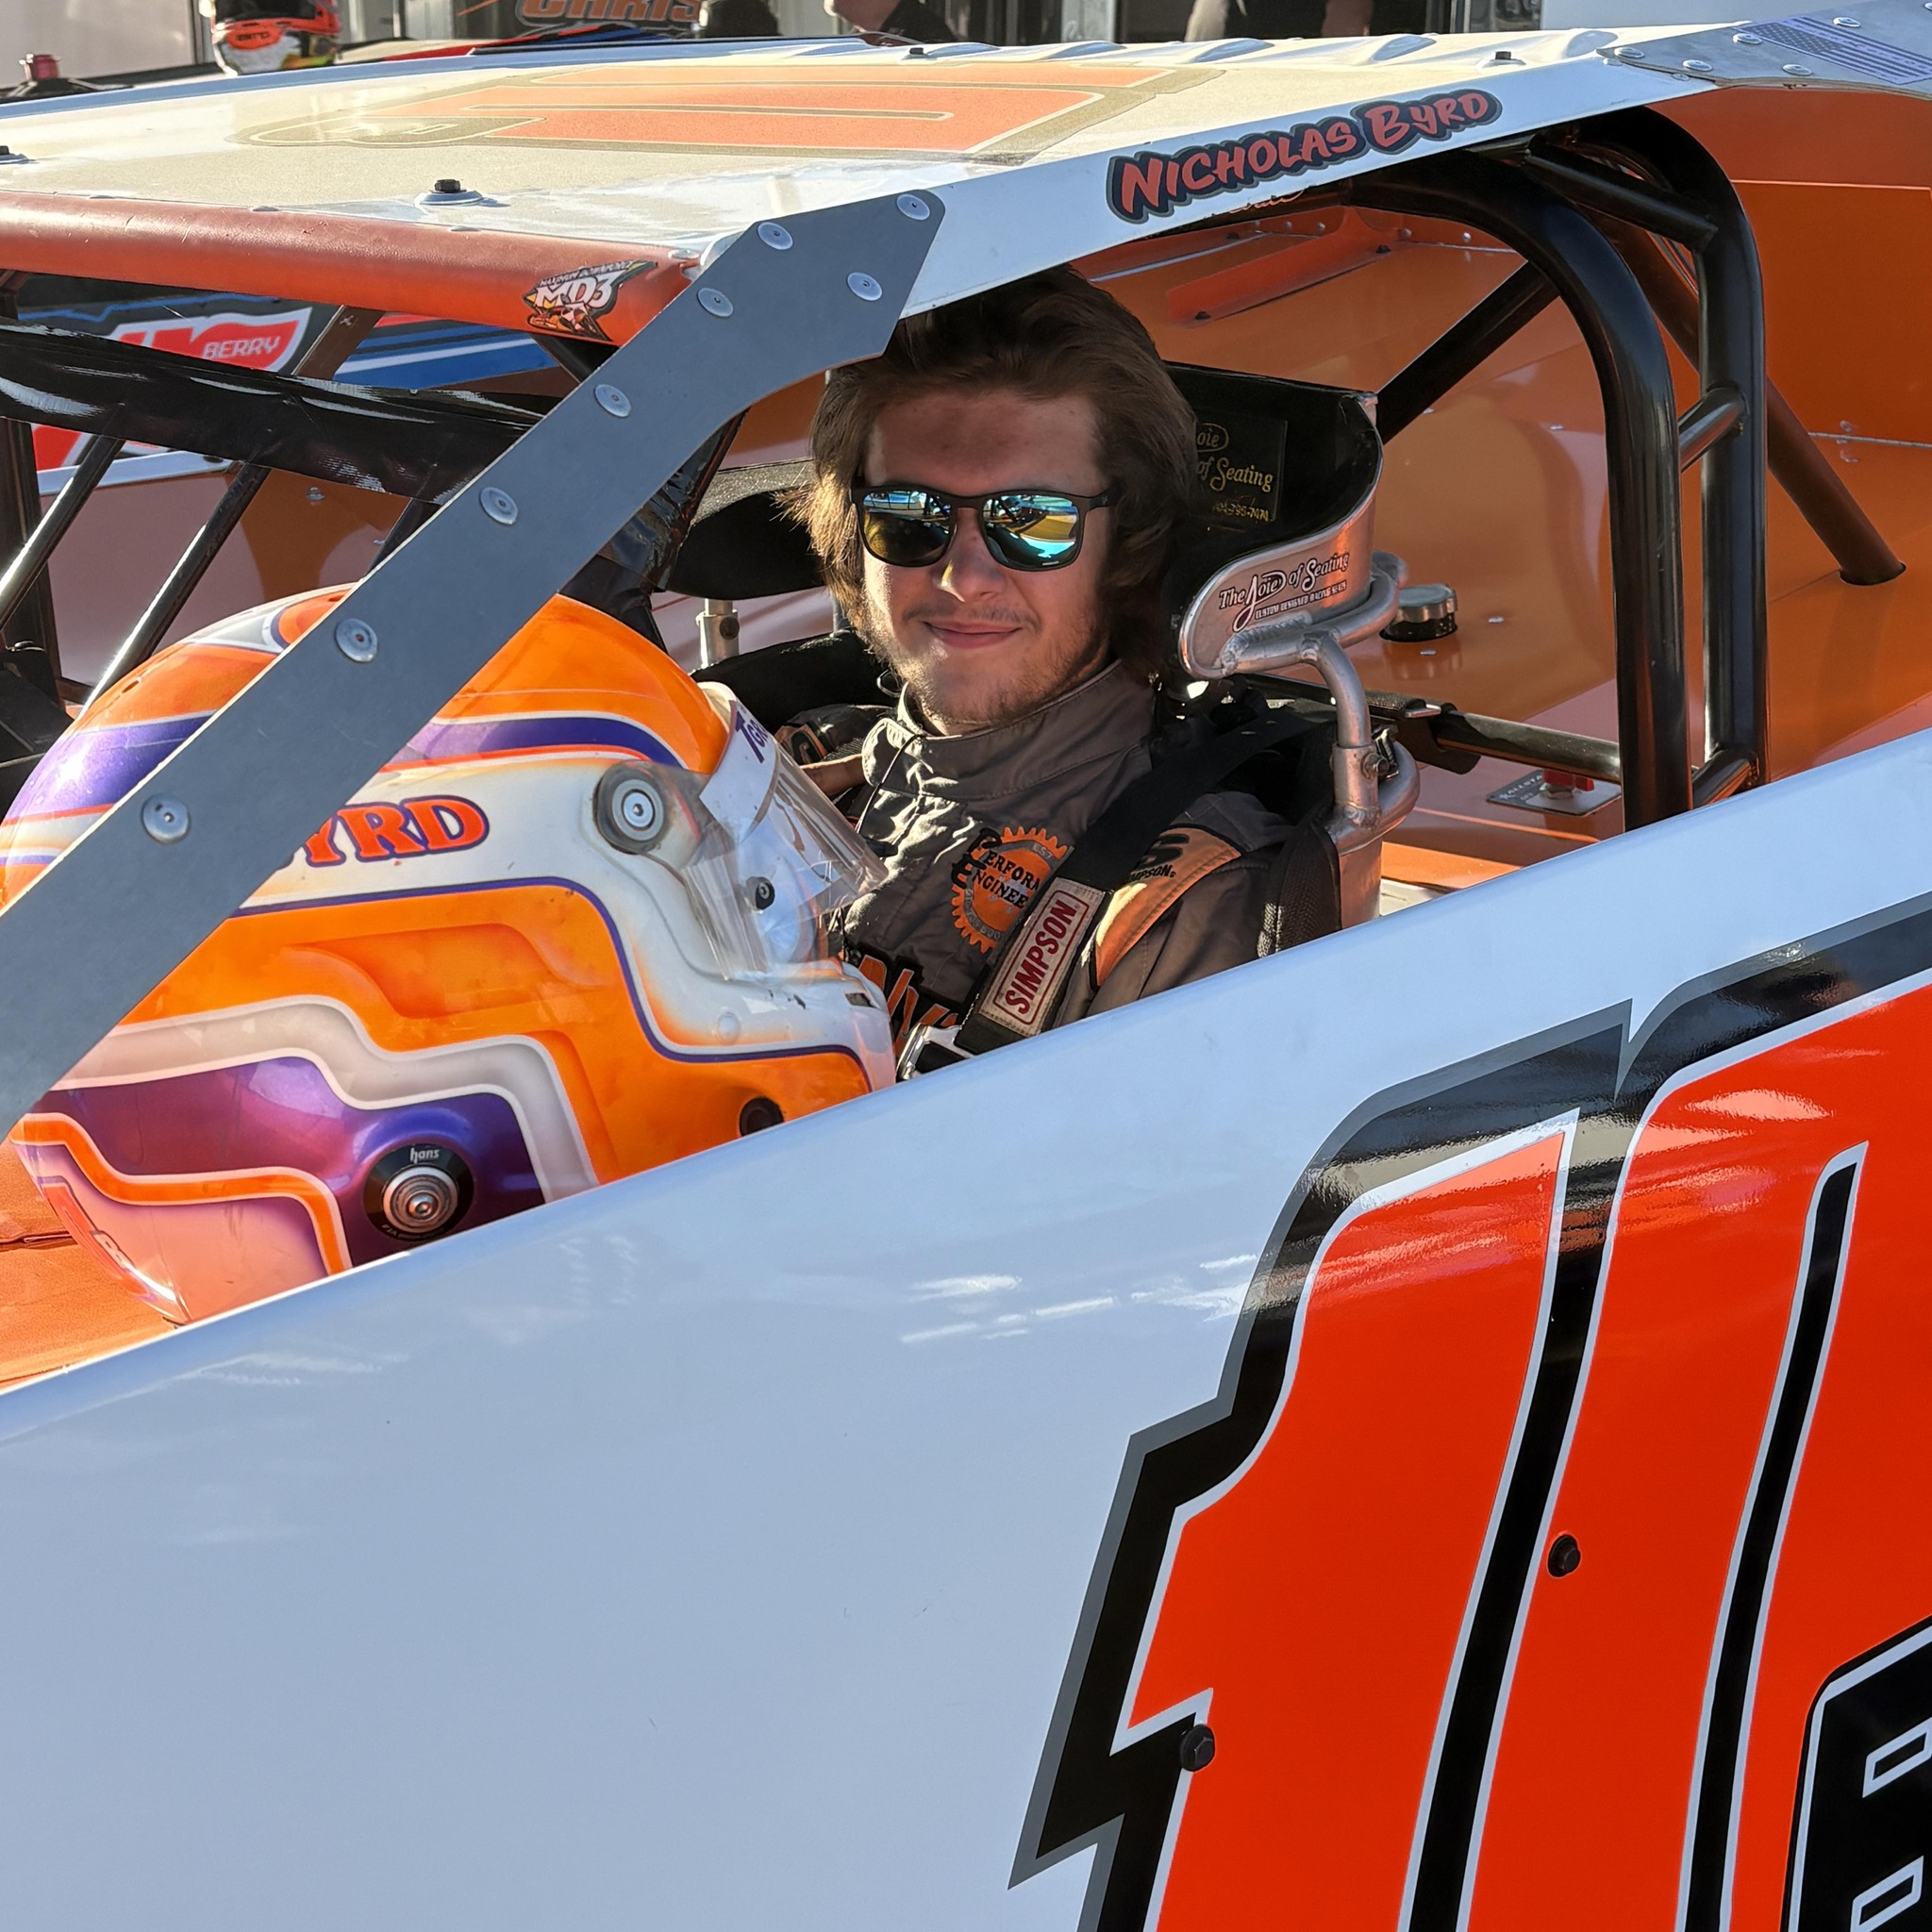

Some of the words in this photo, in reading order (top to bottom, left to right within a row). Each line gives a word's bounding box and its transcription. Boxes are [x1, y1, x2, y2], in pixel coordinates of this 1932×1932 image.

[1121, 120, 1358, 214] NICHOLAS
[534, 271, 624, 308] MD3
[203, 336, 280, 358] BERRY
[1196, 427, 1220, 448] oie
[1209, 457, 1274, 492] Seating
[1219, 587, 1246, 609] The
[1288, 563, 1304, 588] of
[1301, 553, 1350, 592] Seating
[304, 794, 490, 868] YRD
[951, 853, 1029, 909] ENGINEE
[1005, 899, 1077, 1015] SIMPSON
[409, 1147, 440, 1164] hans
